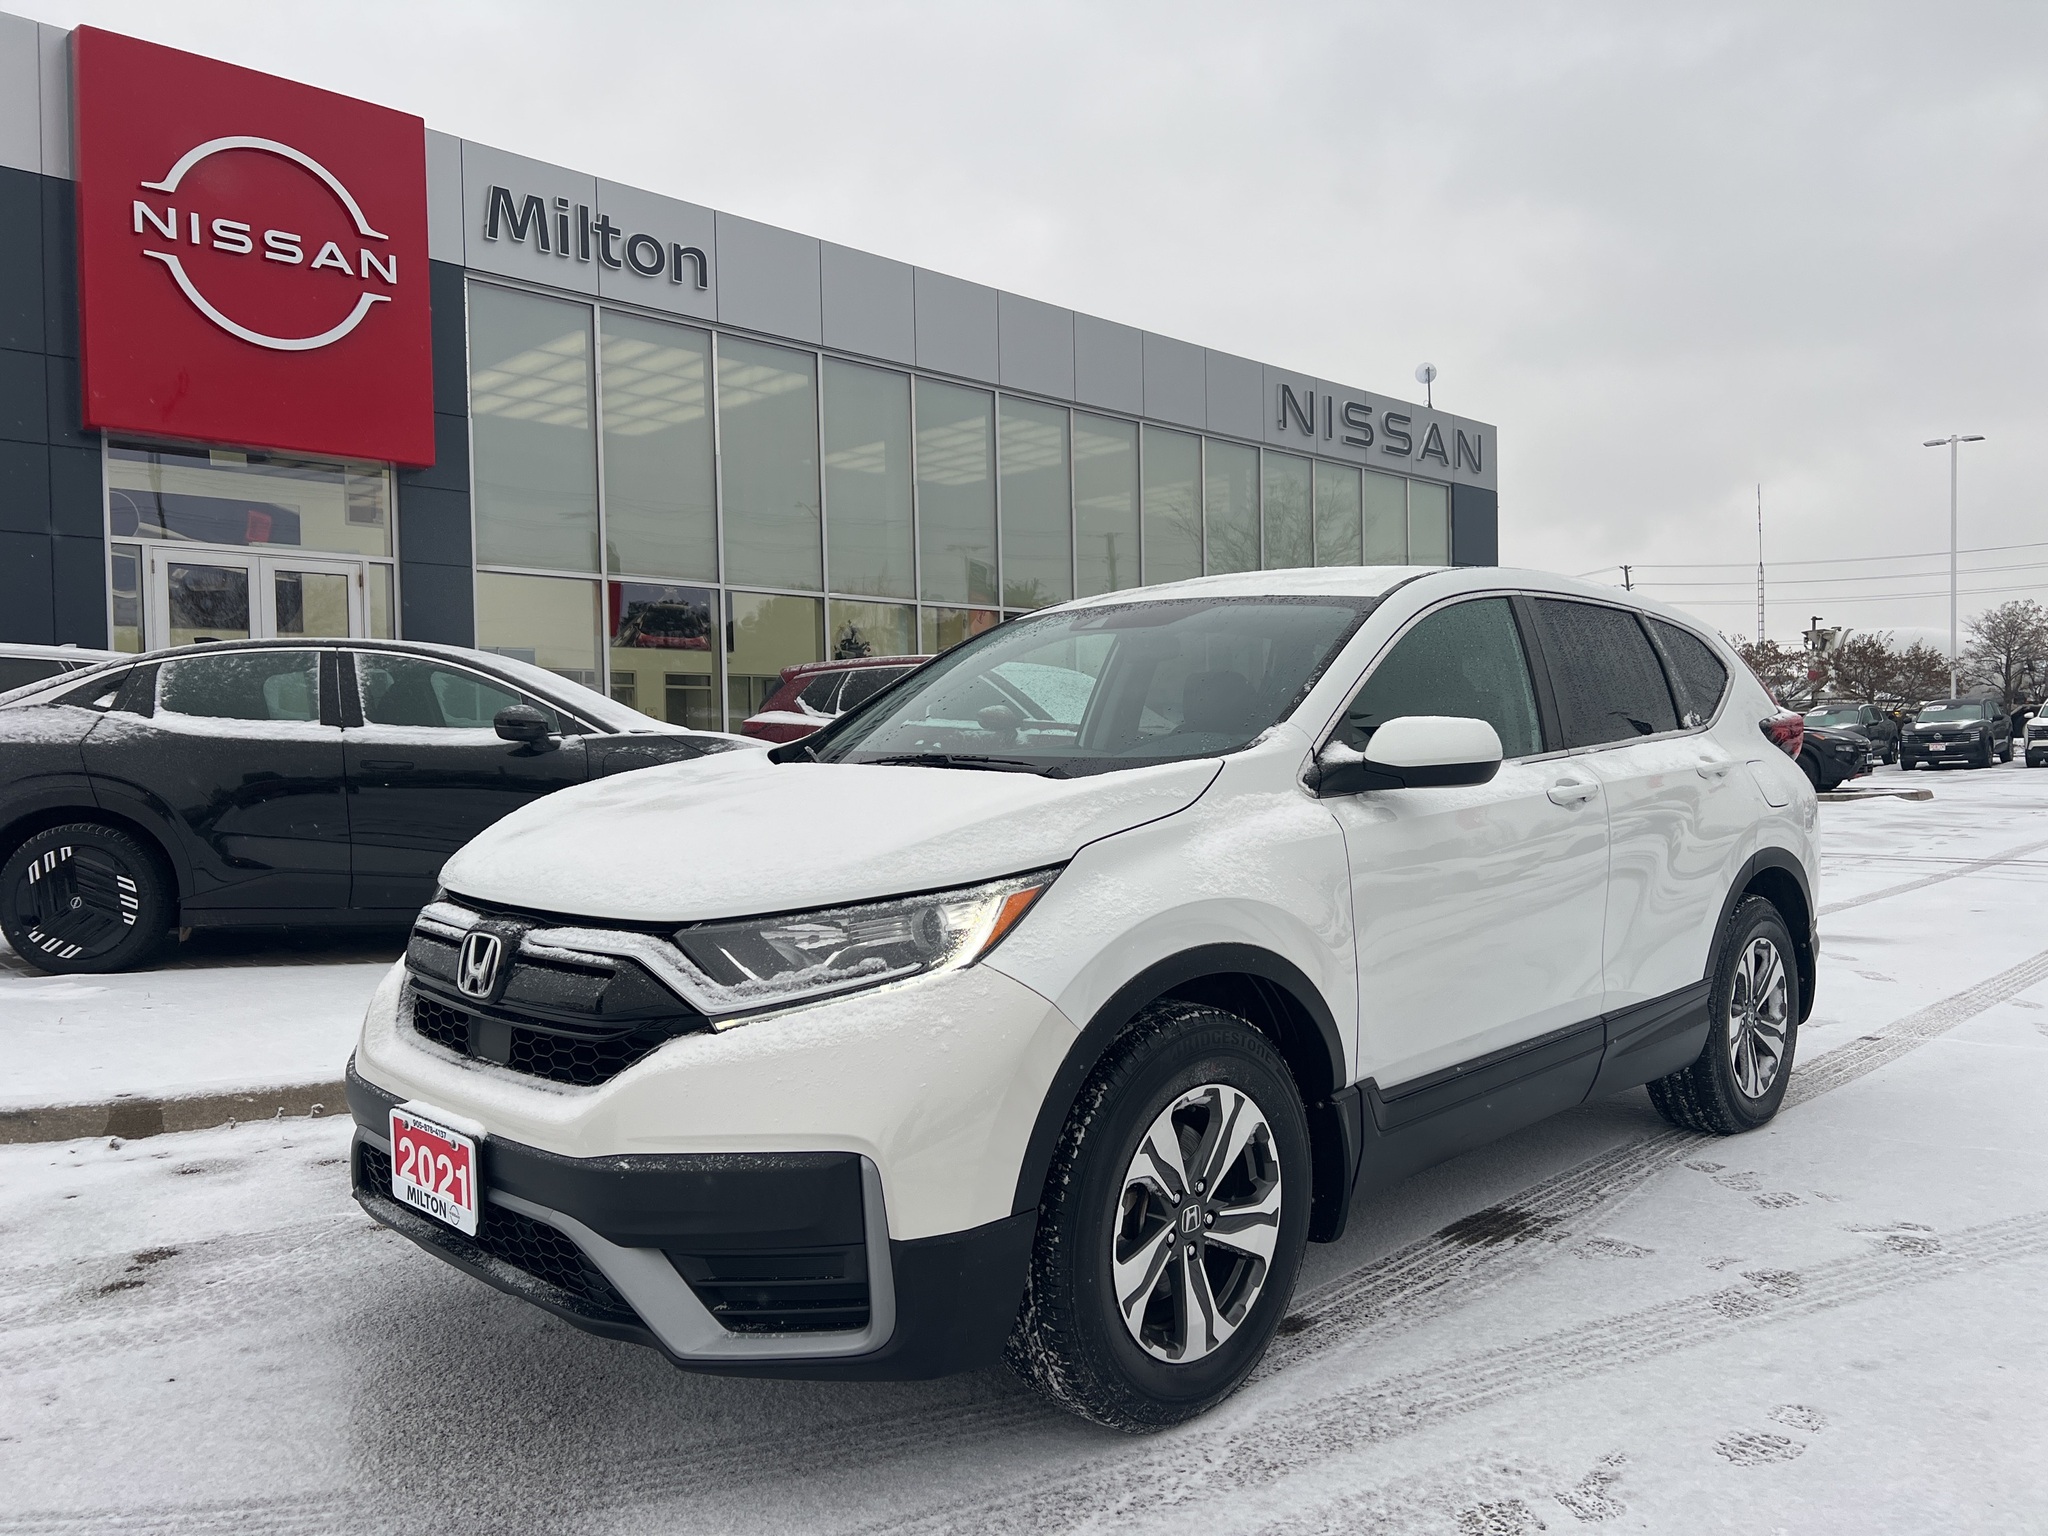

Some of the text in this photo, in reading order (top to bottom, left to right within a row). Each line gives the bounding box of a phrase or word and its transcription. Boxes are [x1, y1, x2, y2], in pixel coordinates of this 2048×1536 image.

[133, 200, 398, 286] NISSAN
[486, 184, 709, 289] Milton
[1278, 383, 1482, 474] NISSAN
[399, 1136, 468, 1209] 2021
[407, 1185, 447, 1219] MILTON
